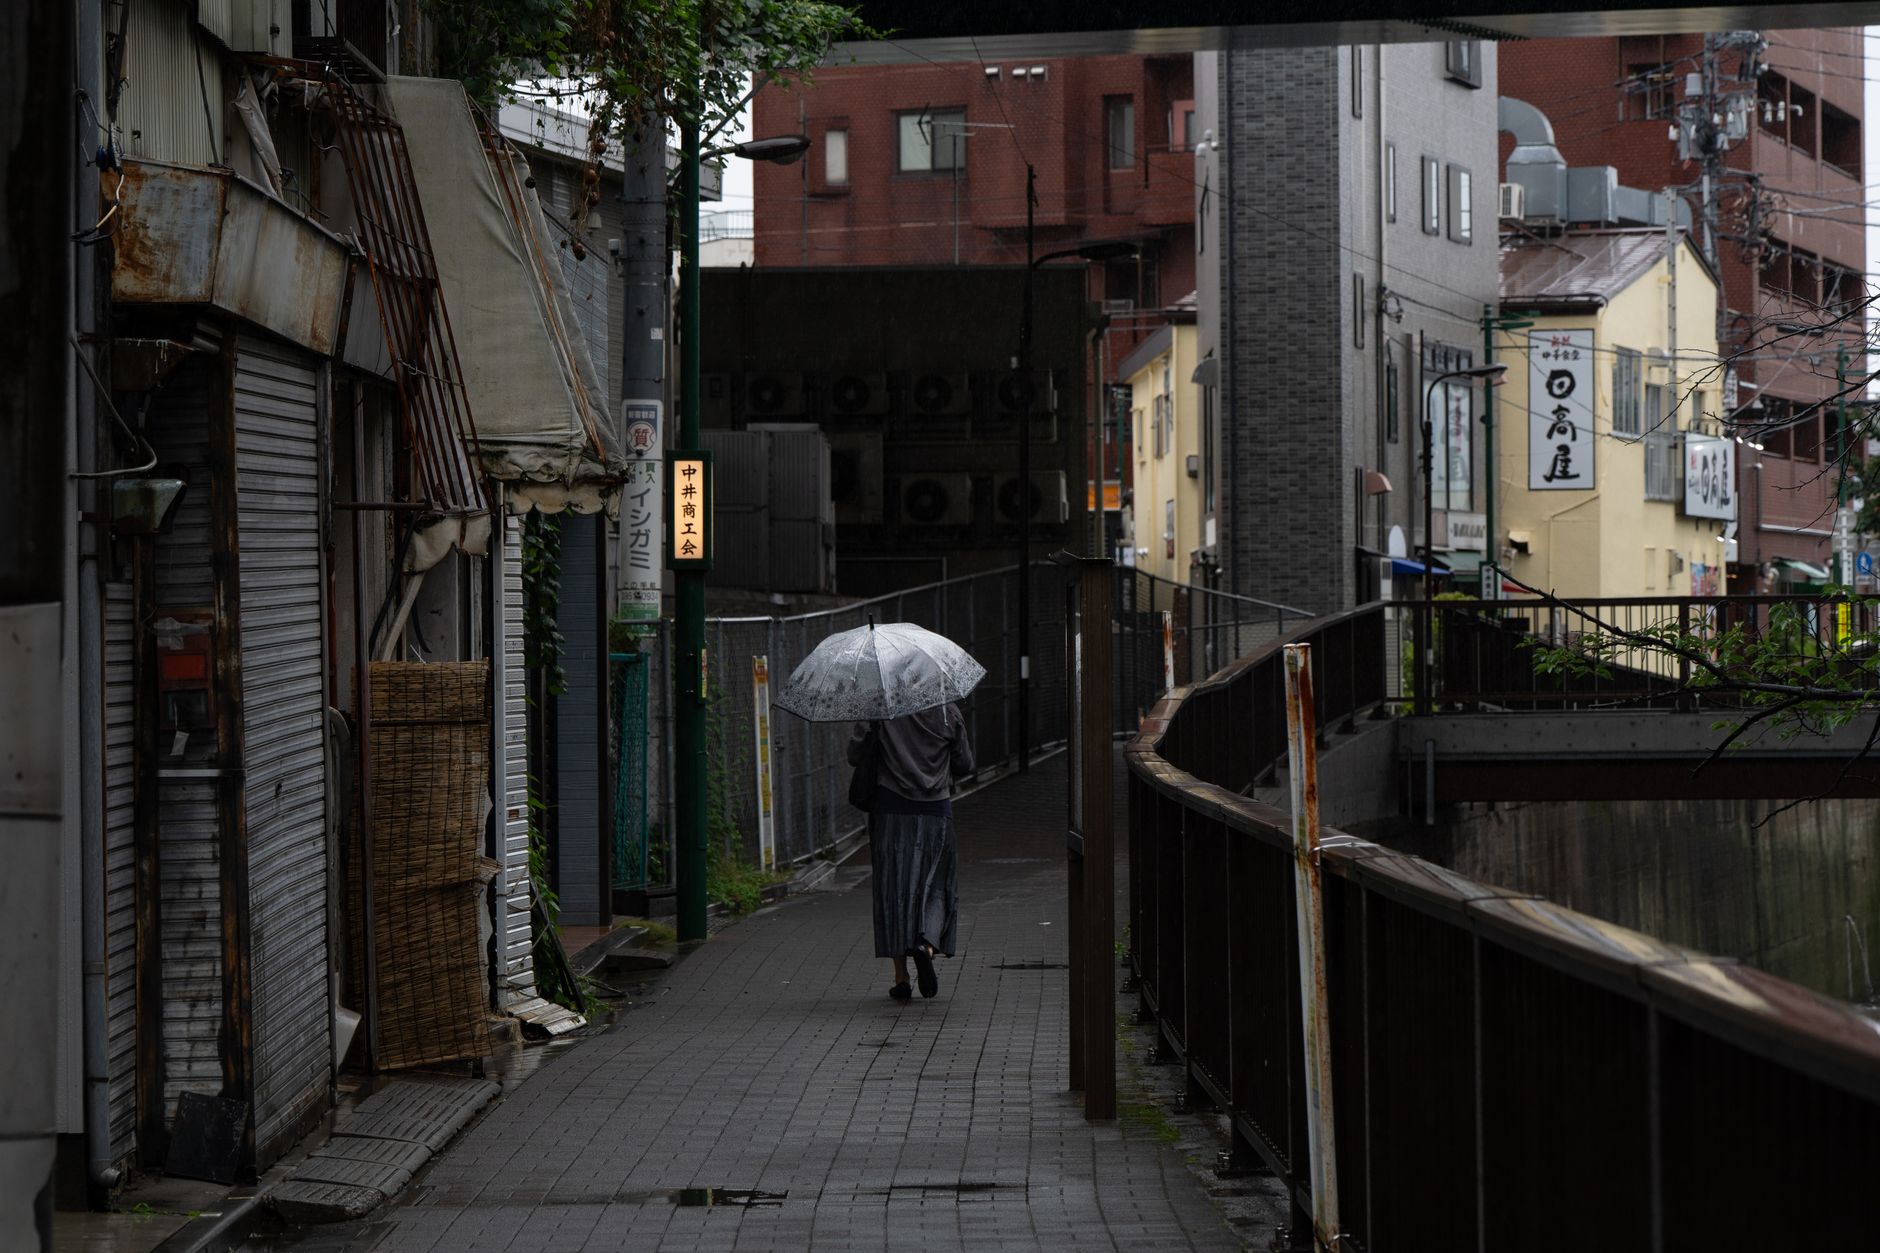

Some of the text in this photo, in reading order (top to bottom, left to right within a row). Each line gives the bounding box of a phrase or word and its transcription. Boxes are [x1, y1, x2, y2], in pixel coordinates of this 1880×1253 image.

[634, 428, 649, 448] 質
[1543, 370, 1580, 482] 日高屋
[645, 463, 656, 484] 買入
[681, 464, 698, 555] 中井商工会
[629, 488, 651, 569] イシガミ
